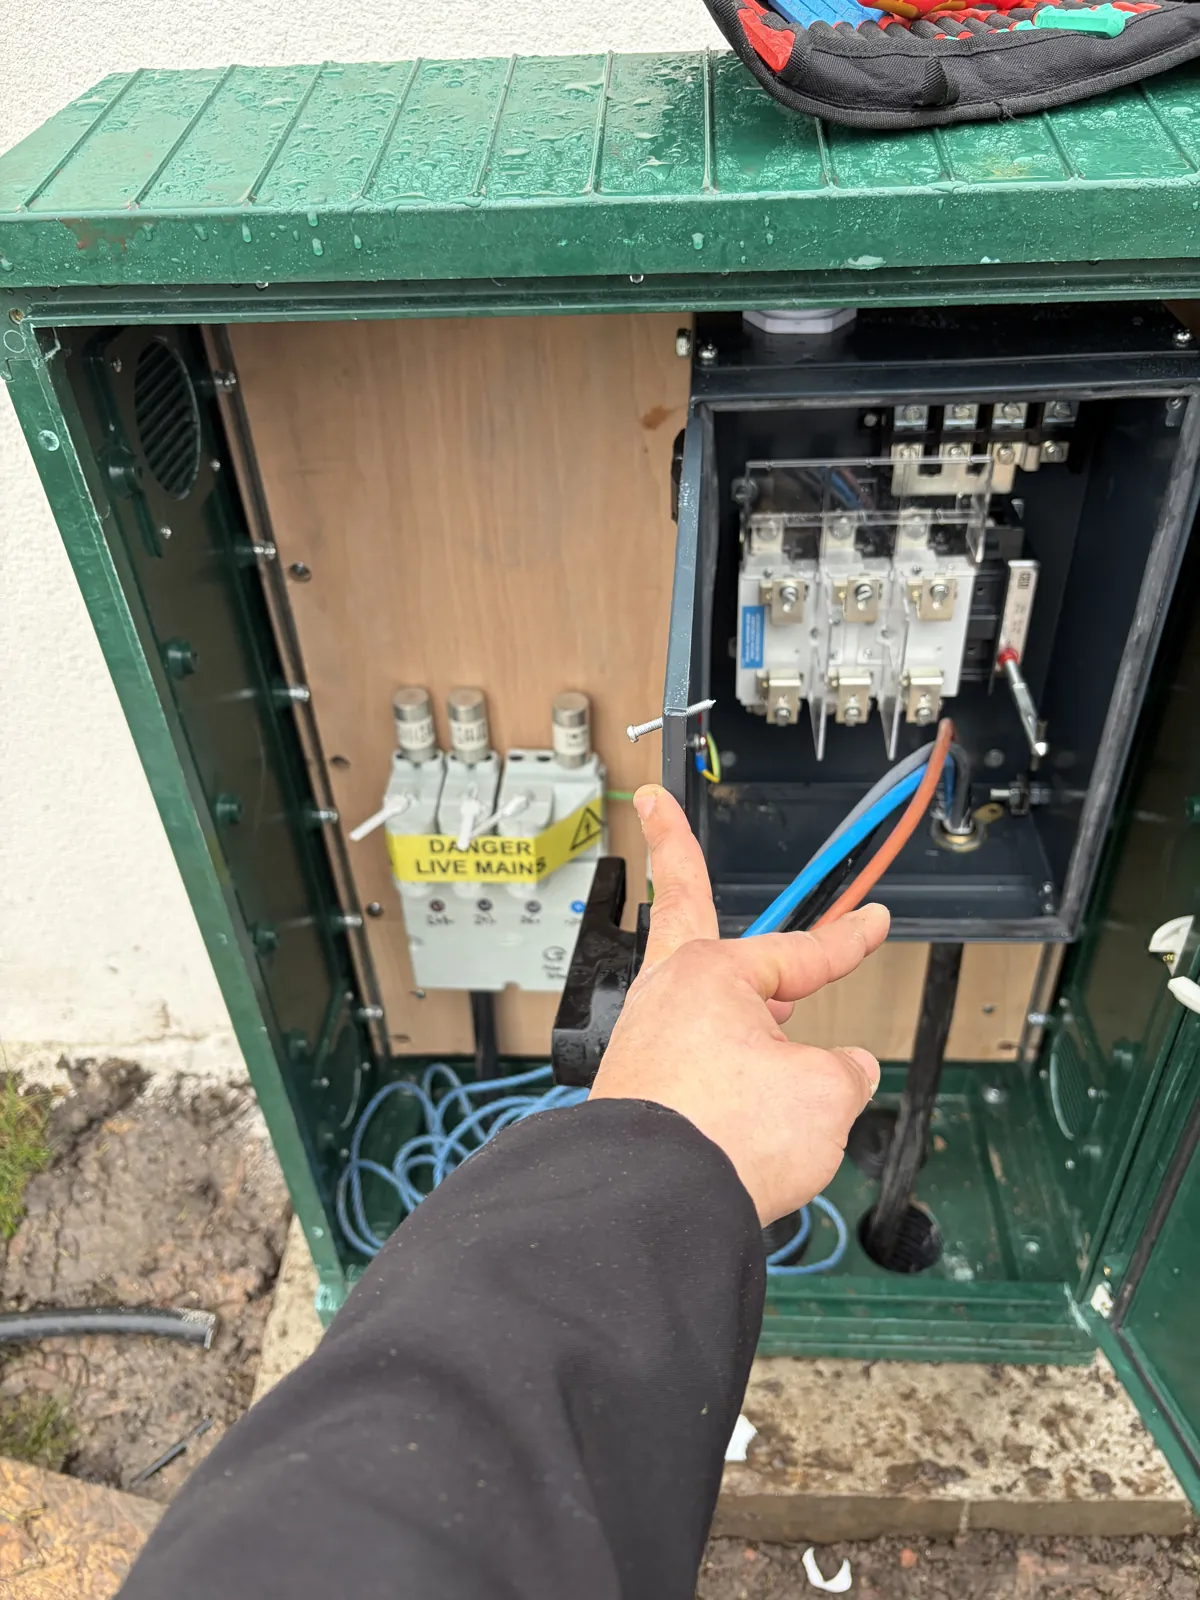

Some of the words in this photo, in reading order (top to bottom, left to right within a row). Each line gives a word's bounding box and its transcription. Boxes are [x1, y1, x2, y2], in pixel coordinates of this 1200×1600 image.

[429, 839, 532, 855] DANGER
[415, 859, 467, 874] LIVE
[475, 856, 547, 875] MAINS
